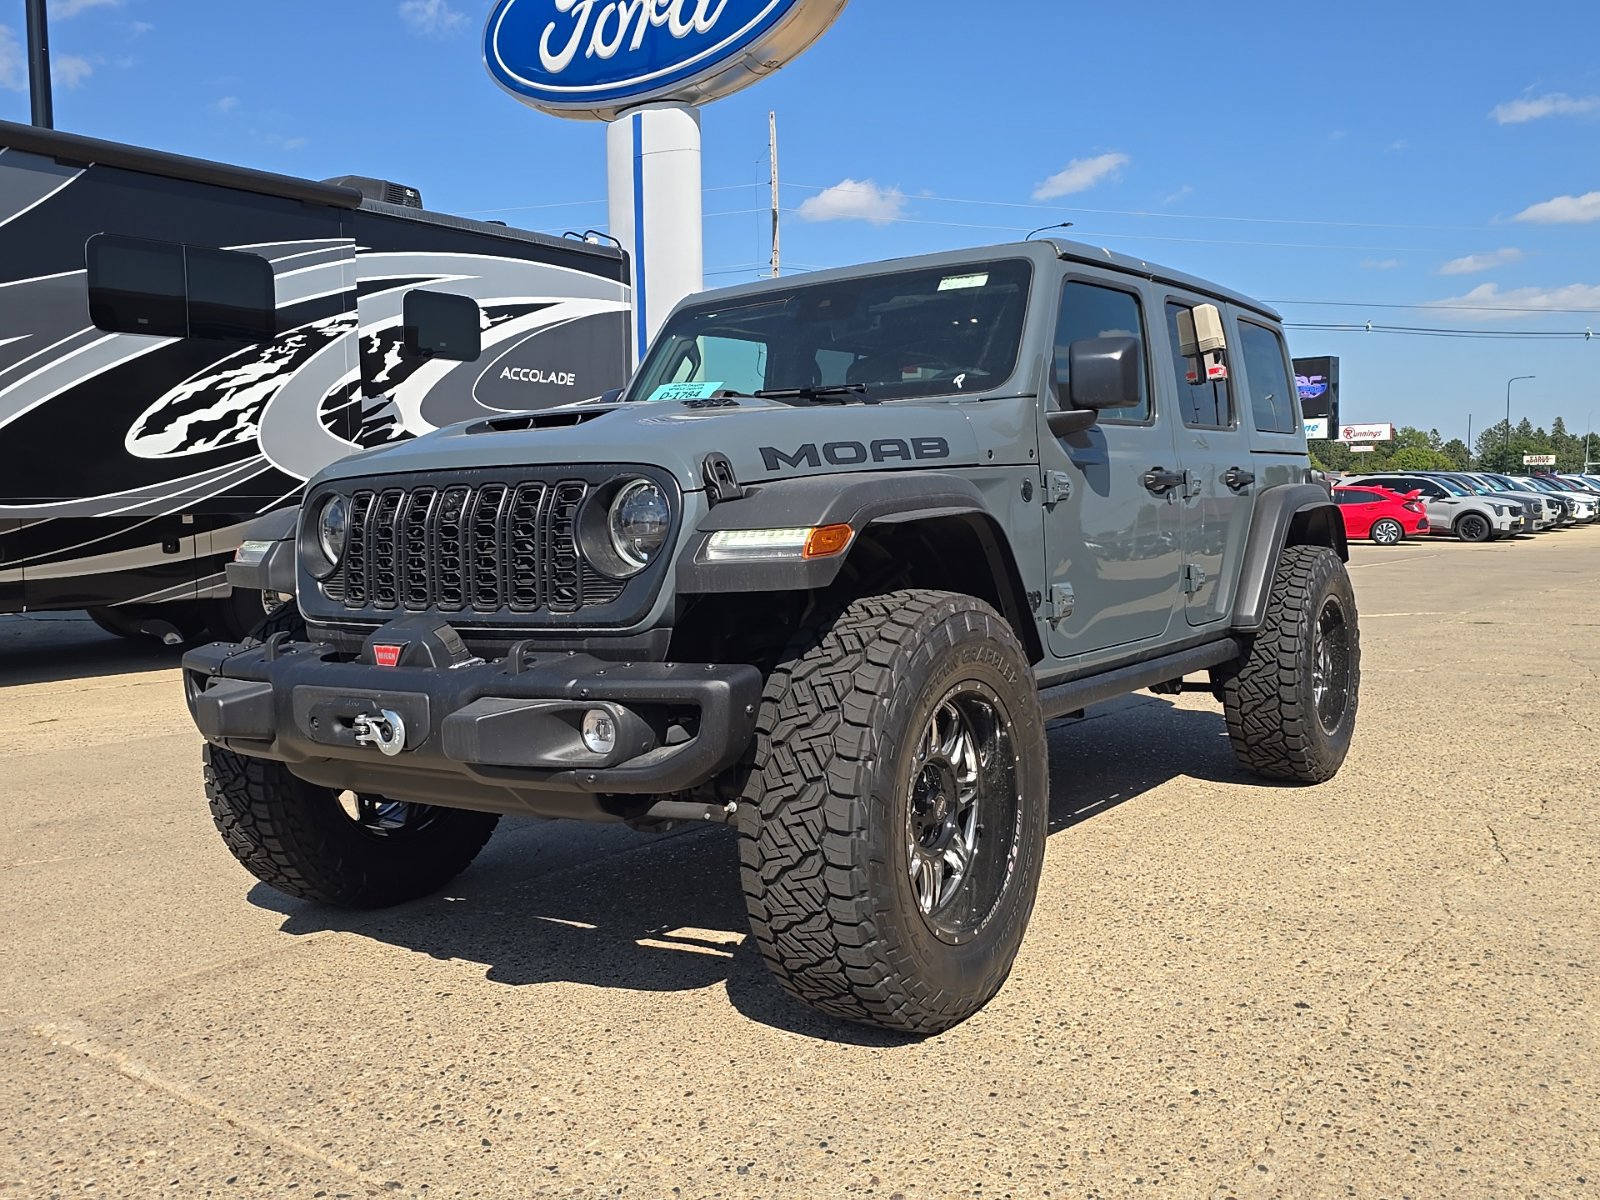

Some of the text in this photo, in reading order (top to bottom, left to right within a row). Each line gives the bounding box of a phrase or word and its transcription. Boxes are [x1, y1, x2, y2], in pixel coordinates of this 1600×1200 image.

[499, 366, 576, 386] ACCOLADE
[659, 390, 702, 400] D-1784
[1342, 426, 1381, 440] Runnings
[758, 436, 950, 471] MOAB
